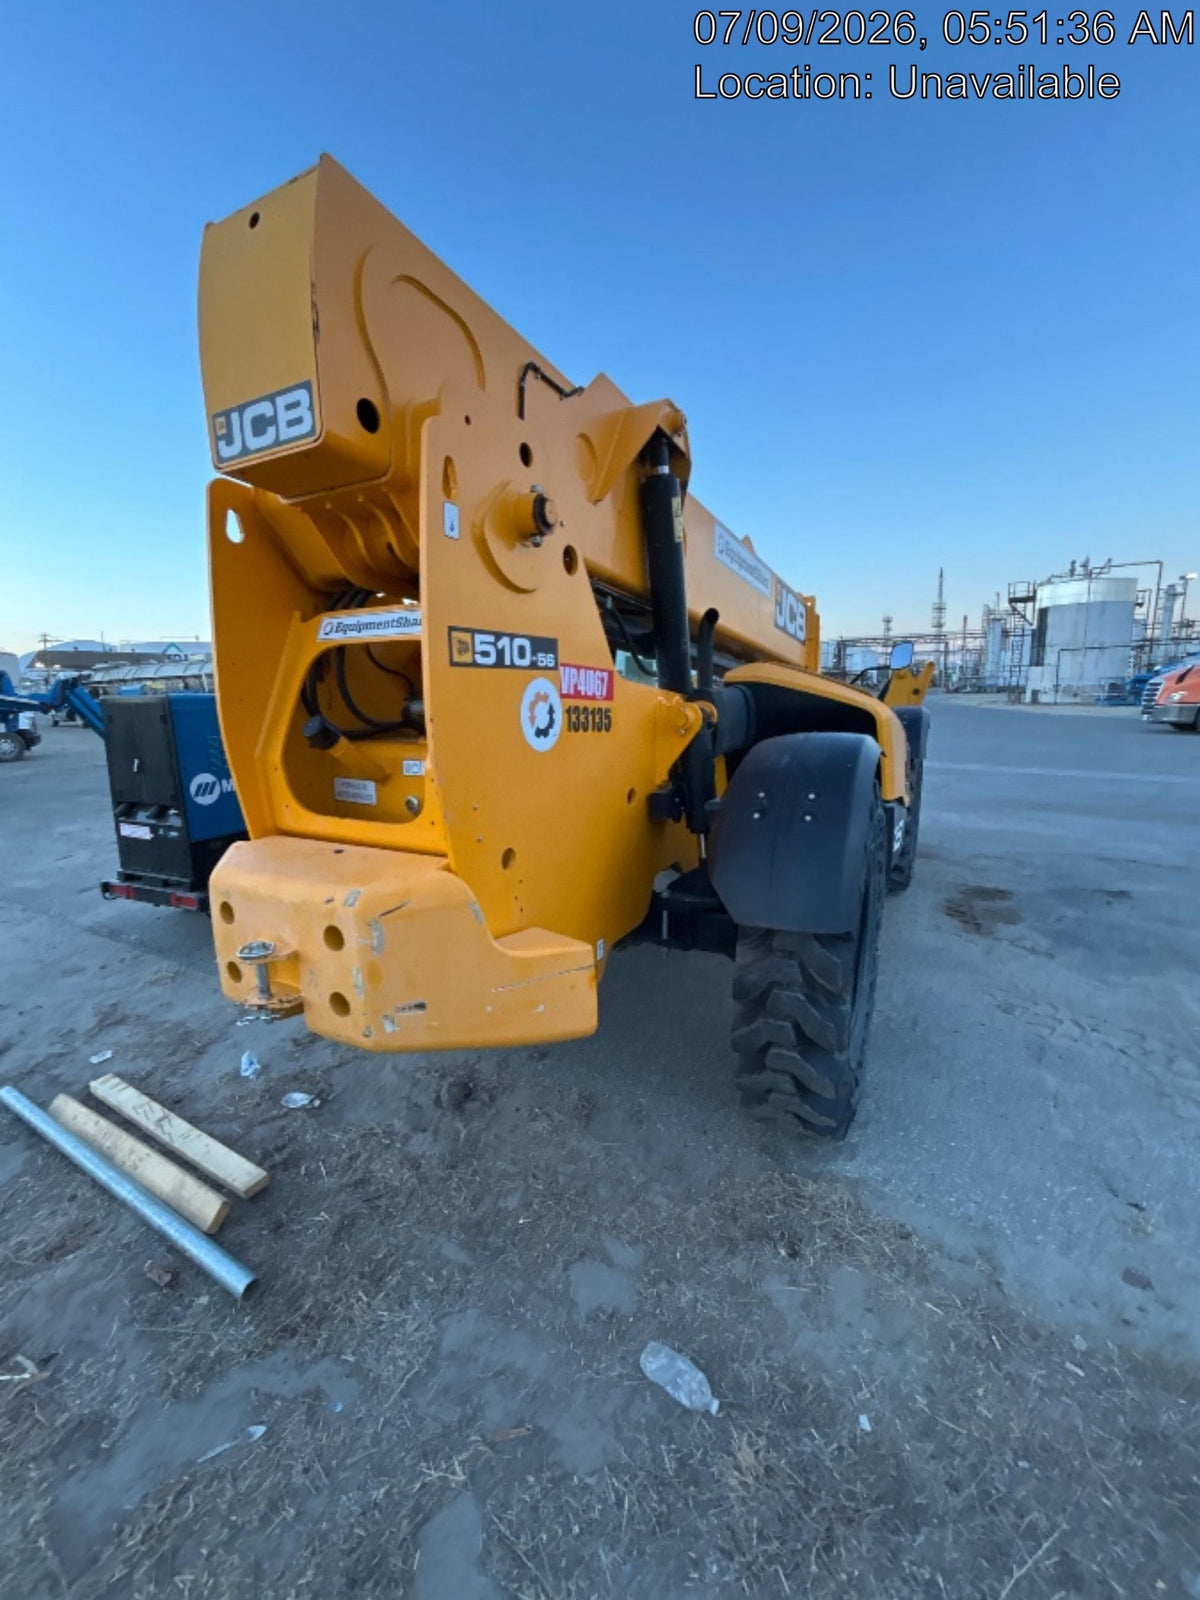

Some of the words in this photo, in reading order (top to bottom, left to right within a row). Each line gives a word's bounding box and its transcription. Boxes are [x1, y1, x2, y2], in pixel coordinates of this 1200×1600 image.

[217, 388, 314, 459] JCB
[334, 615, 422, 635] EquipmentSha
[775, 586, 806, 642] JCB
[565, 705, 612, 733] 133135
